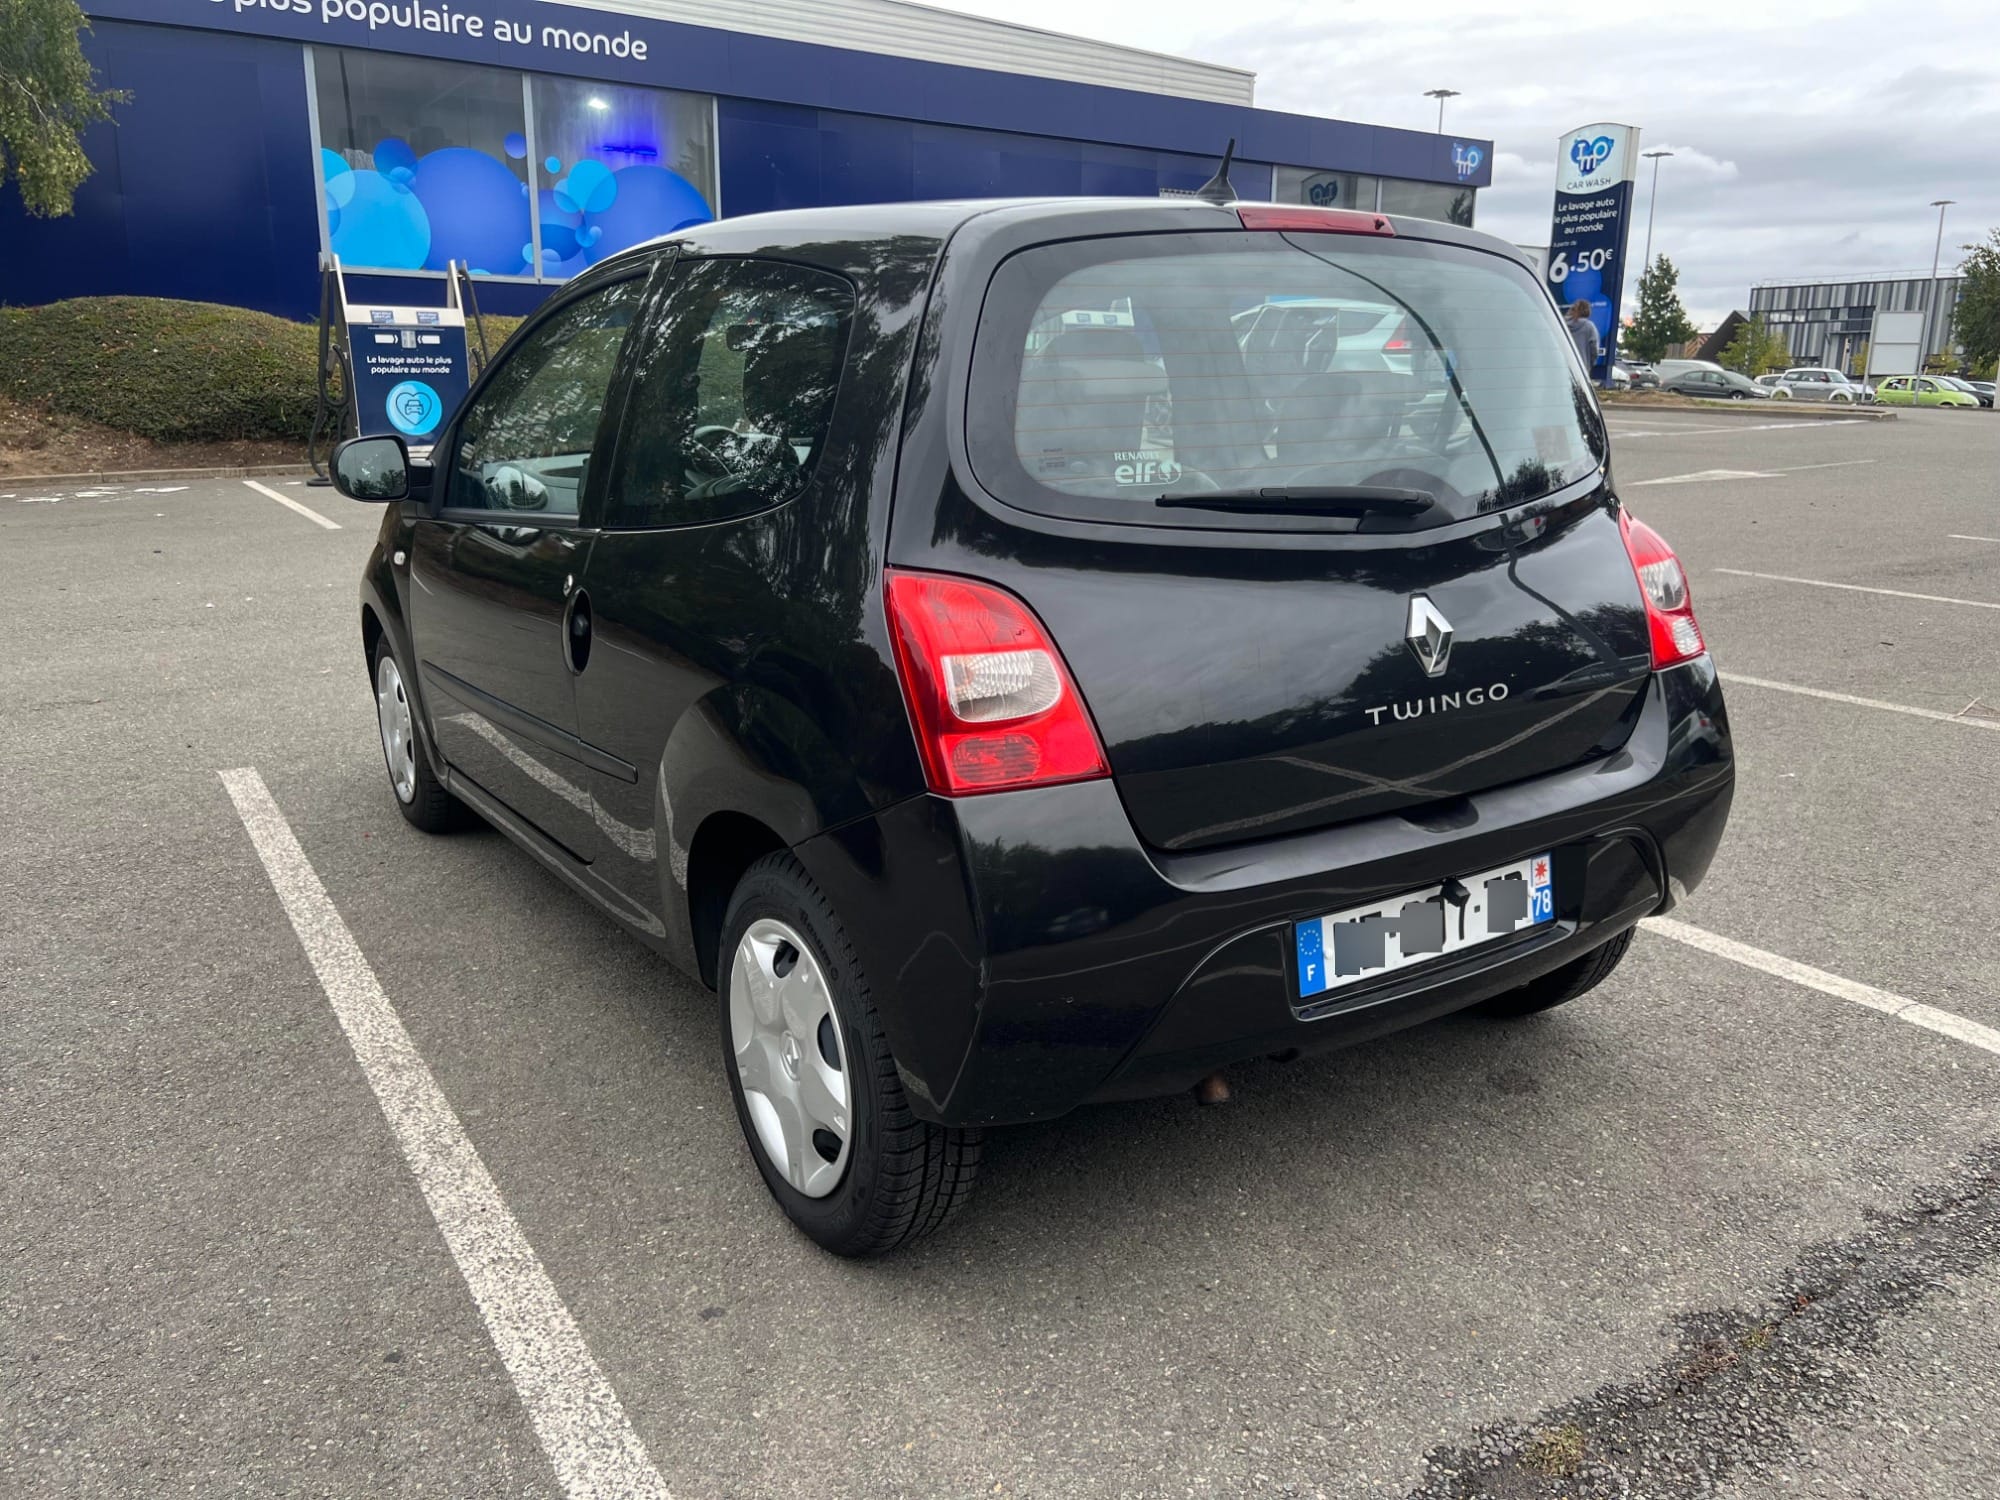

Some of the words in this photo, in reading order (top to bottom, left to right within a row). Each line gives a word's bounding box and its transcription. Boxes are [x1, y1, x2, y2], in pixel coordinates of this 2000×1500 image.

[321, 0, 484, 38] populaire
[493, 19, 532, 45] au
[542, 27, 648, 61] monde
[1567, 180, 1584, 190] CAR
[1585, 176, 1611, 187] WASH
[1558, 203, 1568, 212] Le
[1568, 201, 1595, 211] lavage
[1595, 198, 1615, 208] auto
[1561, 213, 1578, 225] plus
[1578, 209, 1618, 223] populaire
[1575, 222, 1604, 233] monde
[366, 355, 377, 364] Le
[377, 355, 405, 365] lavage
[406, 356, 425, 364] auto
[425, 355, 434, 364] le
[434, 355, 453, 365] plus
[371, 366, 409, 375] populaire
[421, 366, 450, 374] monde
[1114, 450, 1160, 461] RENAULT
[1114, 462, 1156, 484] elf
[1364, 682, 1509, 726] TWINGO
[1533, 889, 1552, 917] 78
[1306, 963, 1316, 982] F
